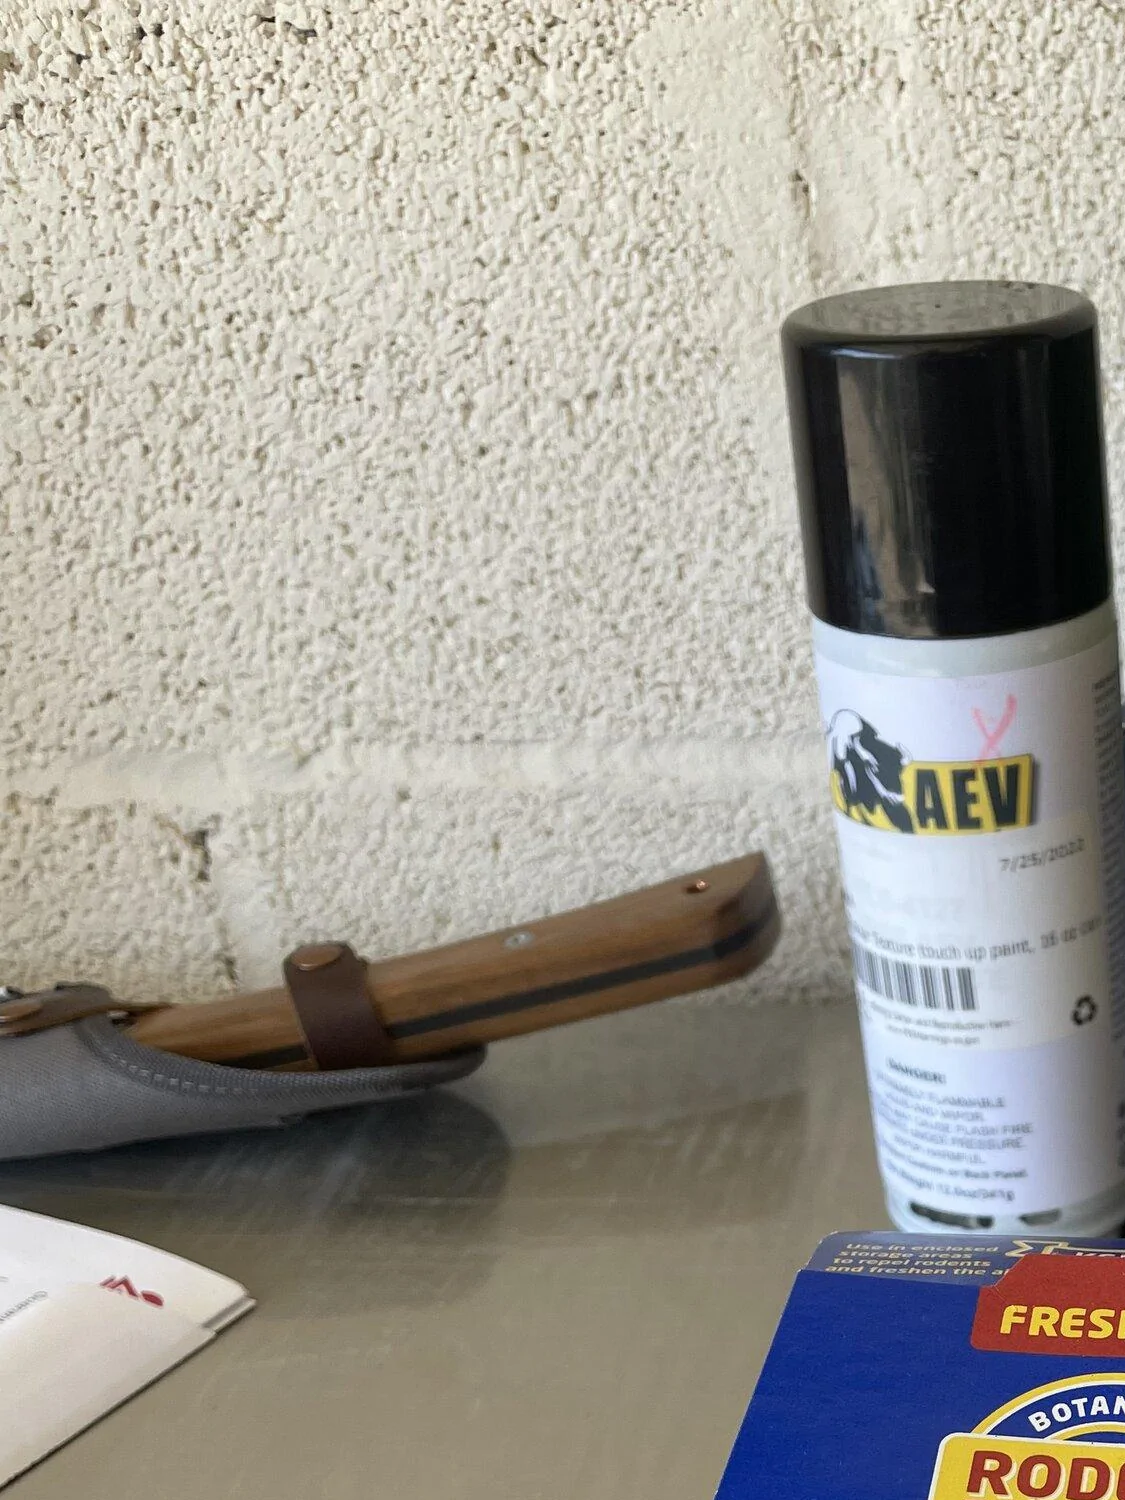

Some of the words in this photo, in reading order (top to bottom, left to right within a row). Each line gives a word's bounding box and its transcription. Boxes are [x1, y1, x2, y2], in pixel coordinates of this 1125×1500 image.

[915, 762, 1020, 830] AEV
[847, 1243, 883, 1251] Use
[888, 1243, 906, 1252] in
[911, 1244, 999, 1253] enclosed
[840, 1250, 916, 1260] storage
[834, 1257, 853, 1265] to
[854, 1258, 911, 1268] repel
[915, 1259, 991, 1267] rodents
[825, 1265, 869, 1273] and
[869, 1266, 948, 1275] freshen
[953, 1267, 987, 1276] the
